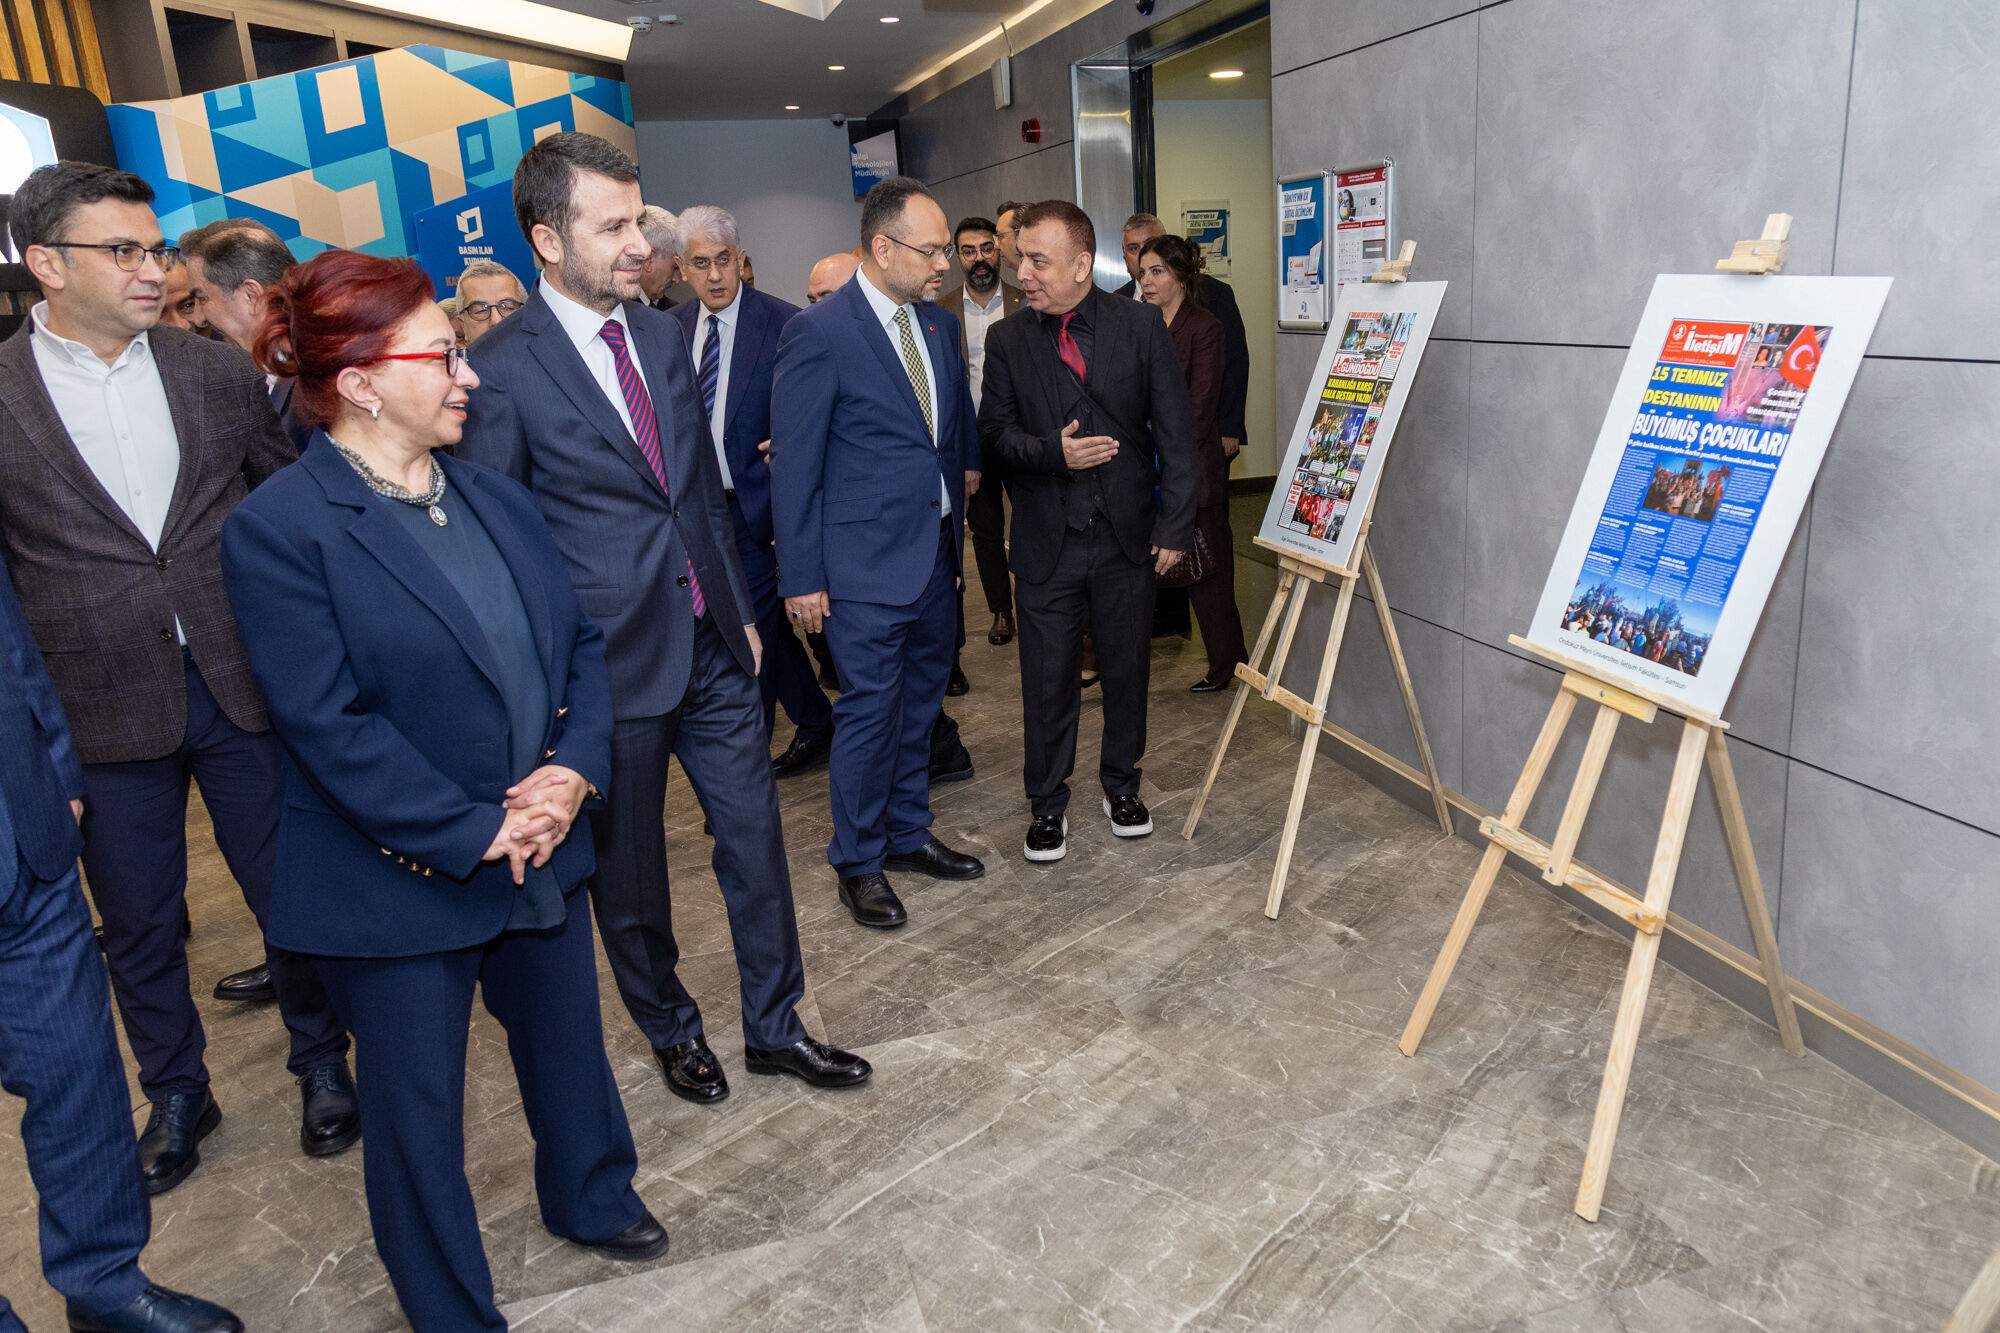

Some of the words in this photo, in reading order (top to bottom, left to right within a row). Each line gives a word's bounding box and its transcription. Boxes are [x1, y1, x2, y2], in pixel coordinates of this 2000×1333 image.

[458, 246, 479, 255] BASIN
[478, 245, 494, 255] İLAN
[1341, 360, 1380, 376] GÜNDOĞDU
[1651, 365, 1667, 381] 15
[1670, 367, 1729, 388] TEMMUZ
[1643, 388, 1722, 413] DESTANININ
[1632, 409, 1701, 449] BÜYÜMÜŞ
[1699, 422, 1790, 457] ÇOCUKLARI
